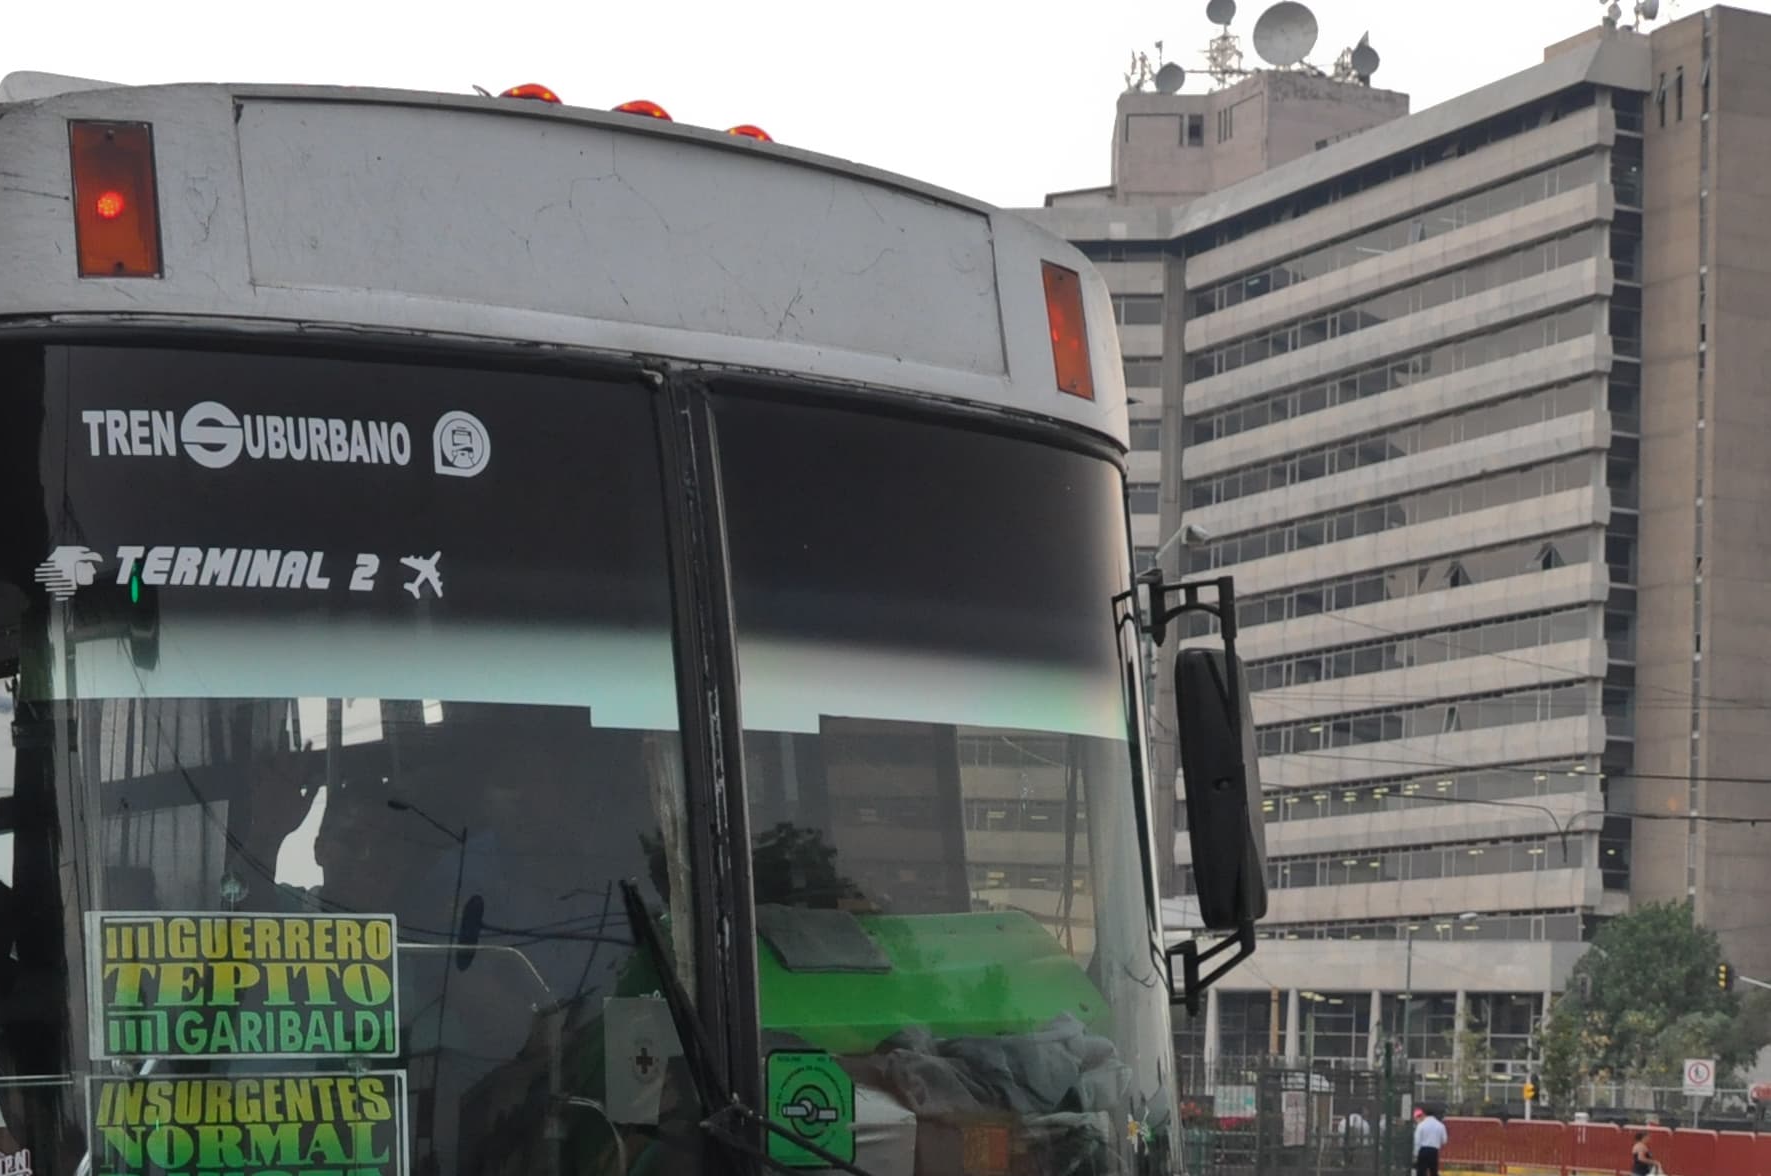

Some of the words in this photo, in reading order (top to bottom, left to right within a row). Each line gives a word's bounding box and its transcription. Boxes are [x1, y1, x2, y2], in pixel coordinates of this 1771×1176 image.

[82, 410, 177, 456] TREN
[180, 400, 412, 469] SUBURBANO
[115, 546, 330, 589] TERMINAL
[349, 553, 380, 591] 2
[168, 918, 391, 960] GUERRERO
[104, 962, 391, 1006] TEPITO
[175, 1010, 394, 1054] GARIBALDI
[96, 1078, 391, 1126] INSURGENTES
[98, 1122, 390, 1169] NORMAL
